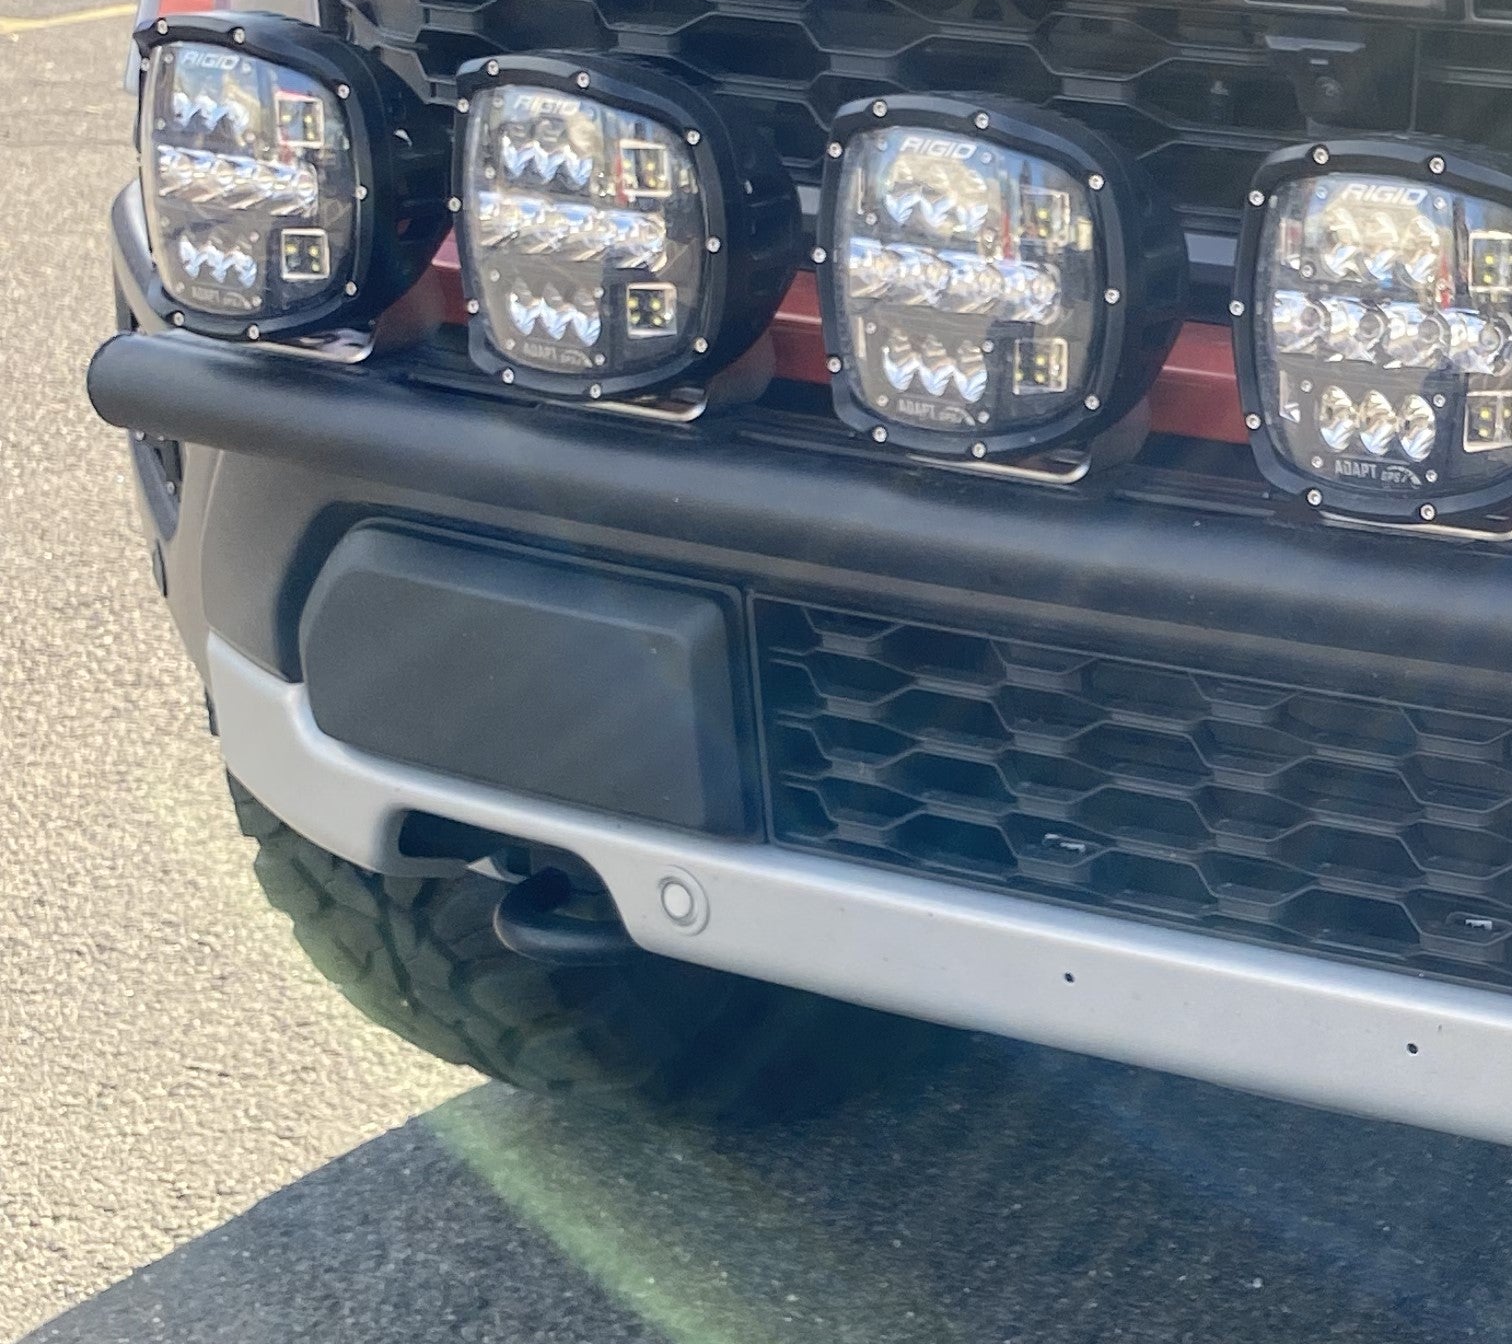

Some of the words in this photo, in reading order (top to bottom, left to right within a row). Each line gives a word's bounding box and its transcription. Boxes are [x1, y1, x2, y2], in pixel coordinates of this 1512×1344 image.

[900, 136, 977, 159] RIGID
[1342, 183, 1428, 206] RIGID
[1334, 459, 1377, 479] ADAPT
